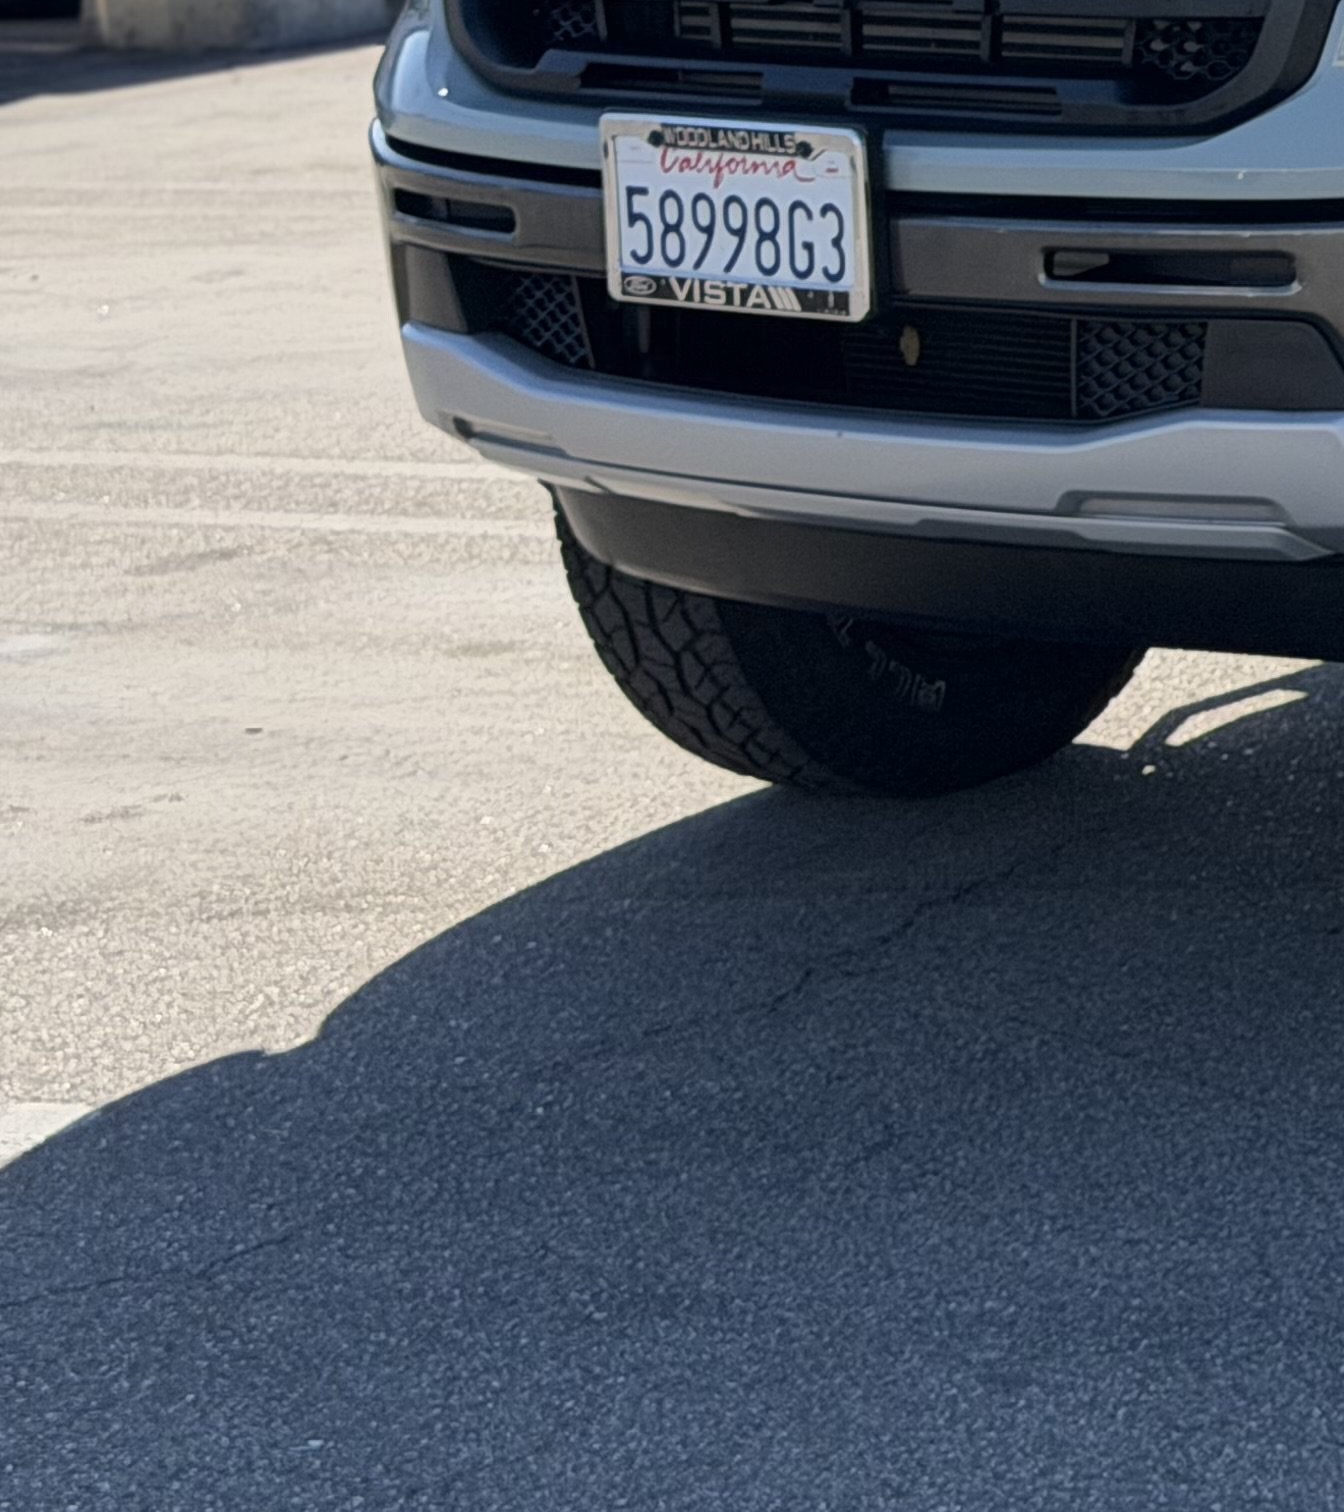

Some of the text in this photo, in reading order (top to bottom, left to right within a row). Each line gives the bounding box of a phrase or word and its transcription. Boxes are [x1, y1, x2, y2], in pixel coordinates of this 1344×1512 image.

[664, 126, 797, 153] WOODLAND HILLS
[659, 145, 815, 188] California
[625, 185, 846, 283] 58998G3
[666, 277, 773, 309] VISTA
